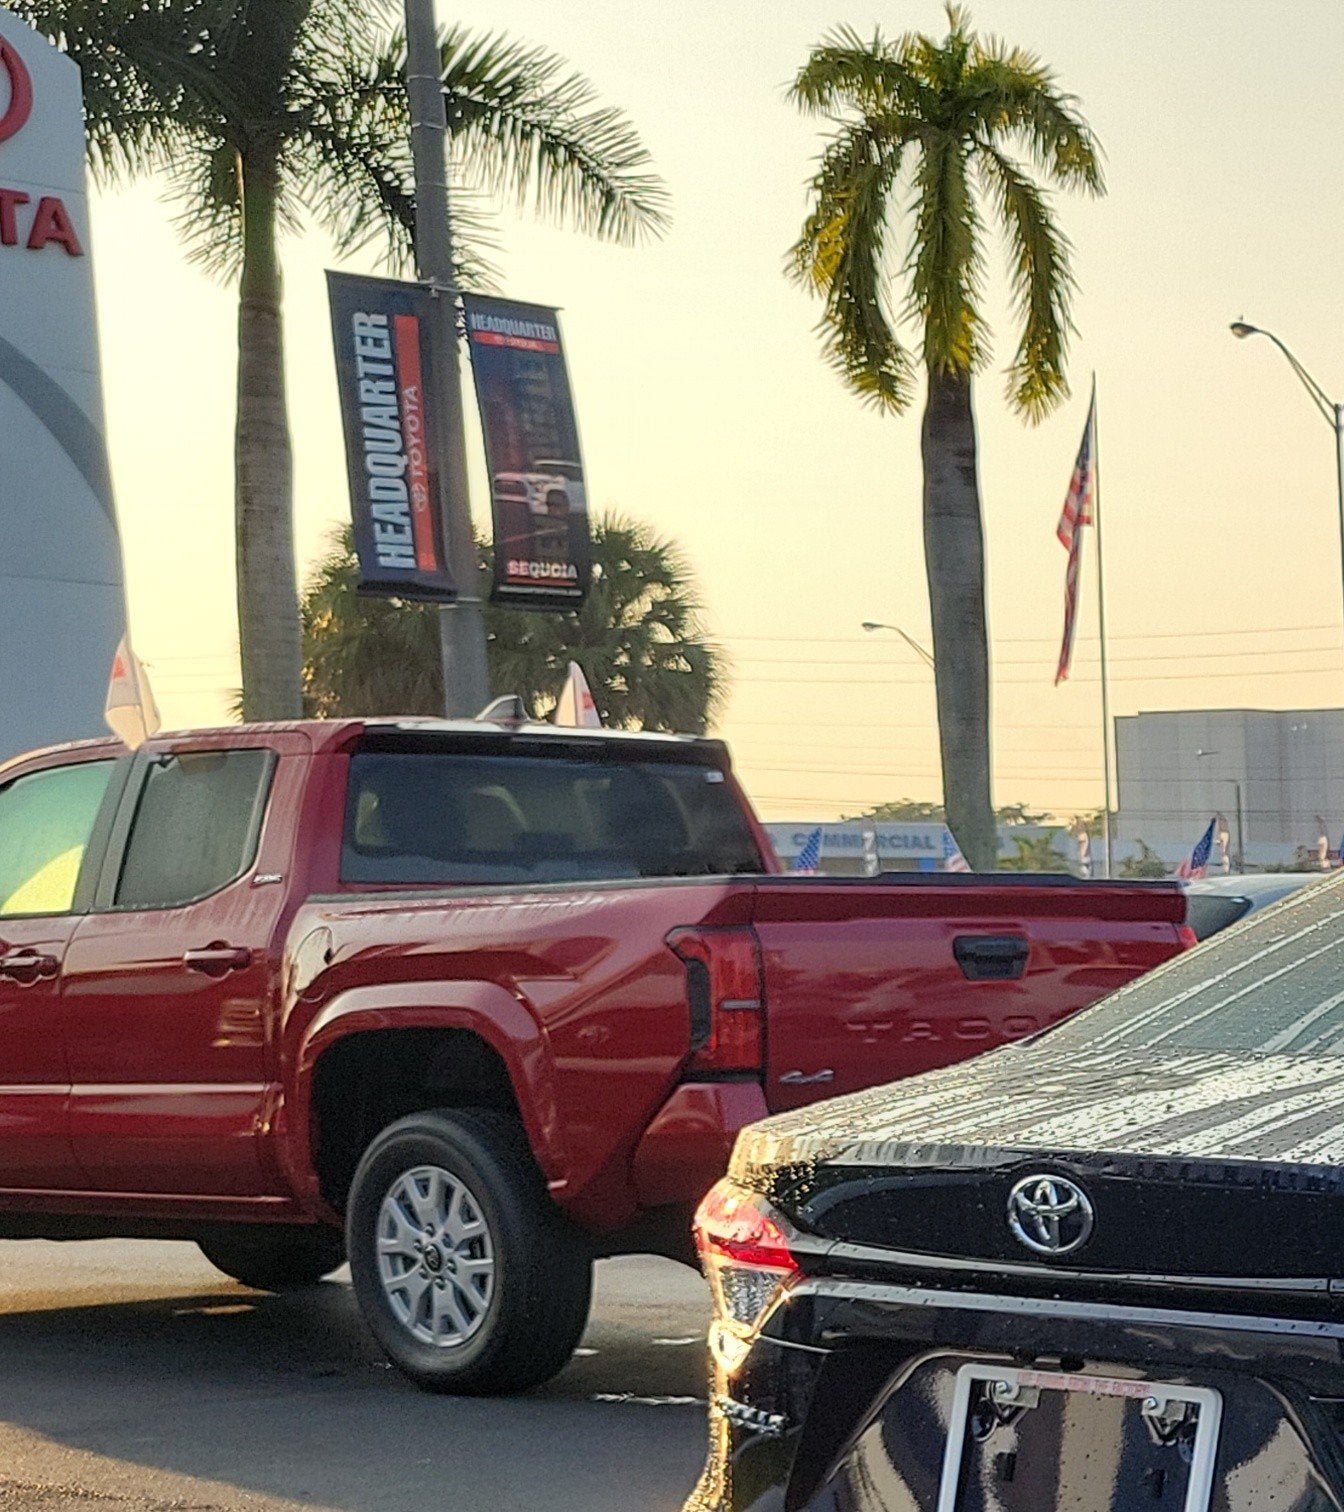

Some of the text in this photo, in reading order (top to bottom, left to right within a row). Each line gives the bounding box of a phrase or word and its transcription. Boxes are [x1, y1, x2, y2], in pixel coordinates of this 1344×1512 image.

[471, 313, 557, 340] HEADQUARTER
[353, 311, 417, 569] HEADQUARTER
[403, 386, 428, 476] TOYOTA
[507, 560, 578, 578] SEQUOIA
[792, 833, 936, 849] CMMRCIAL
